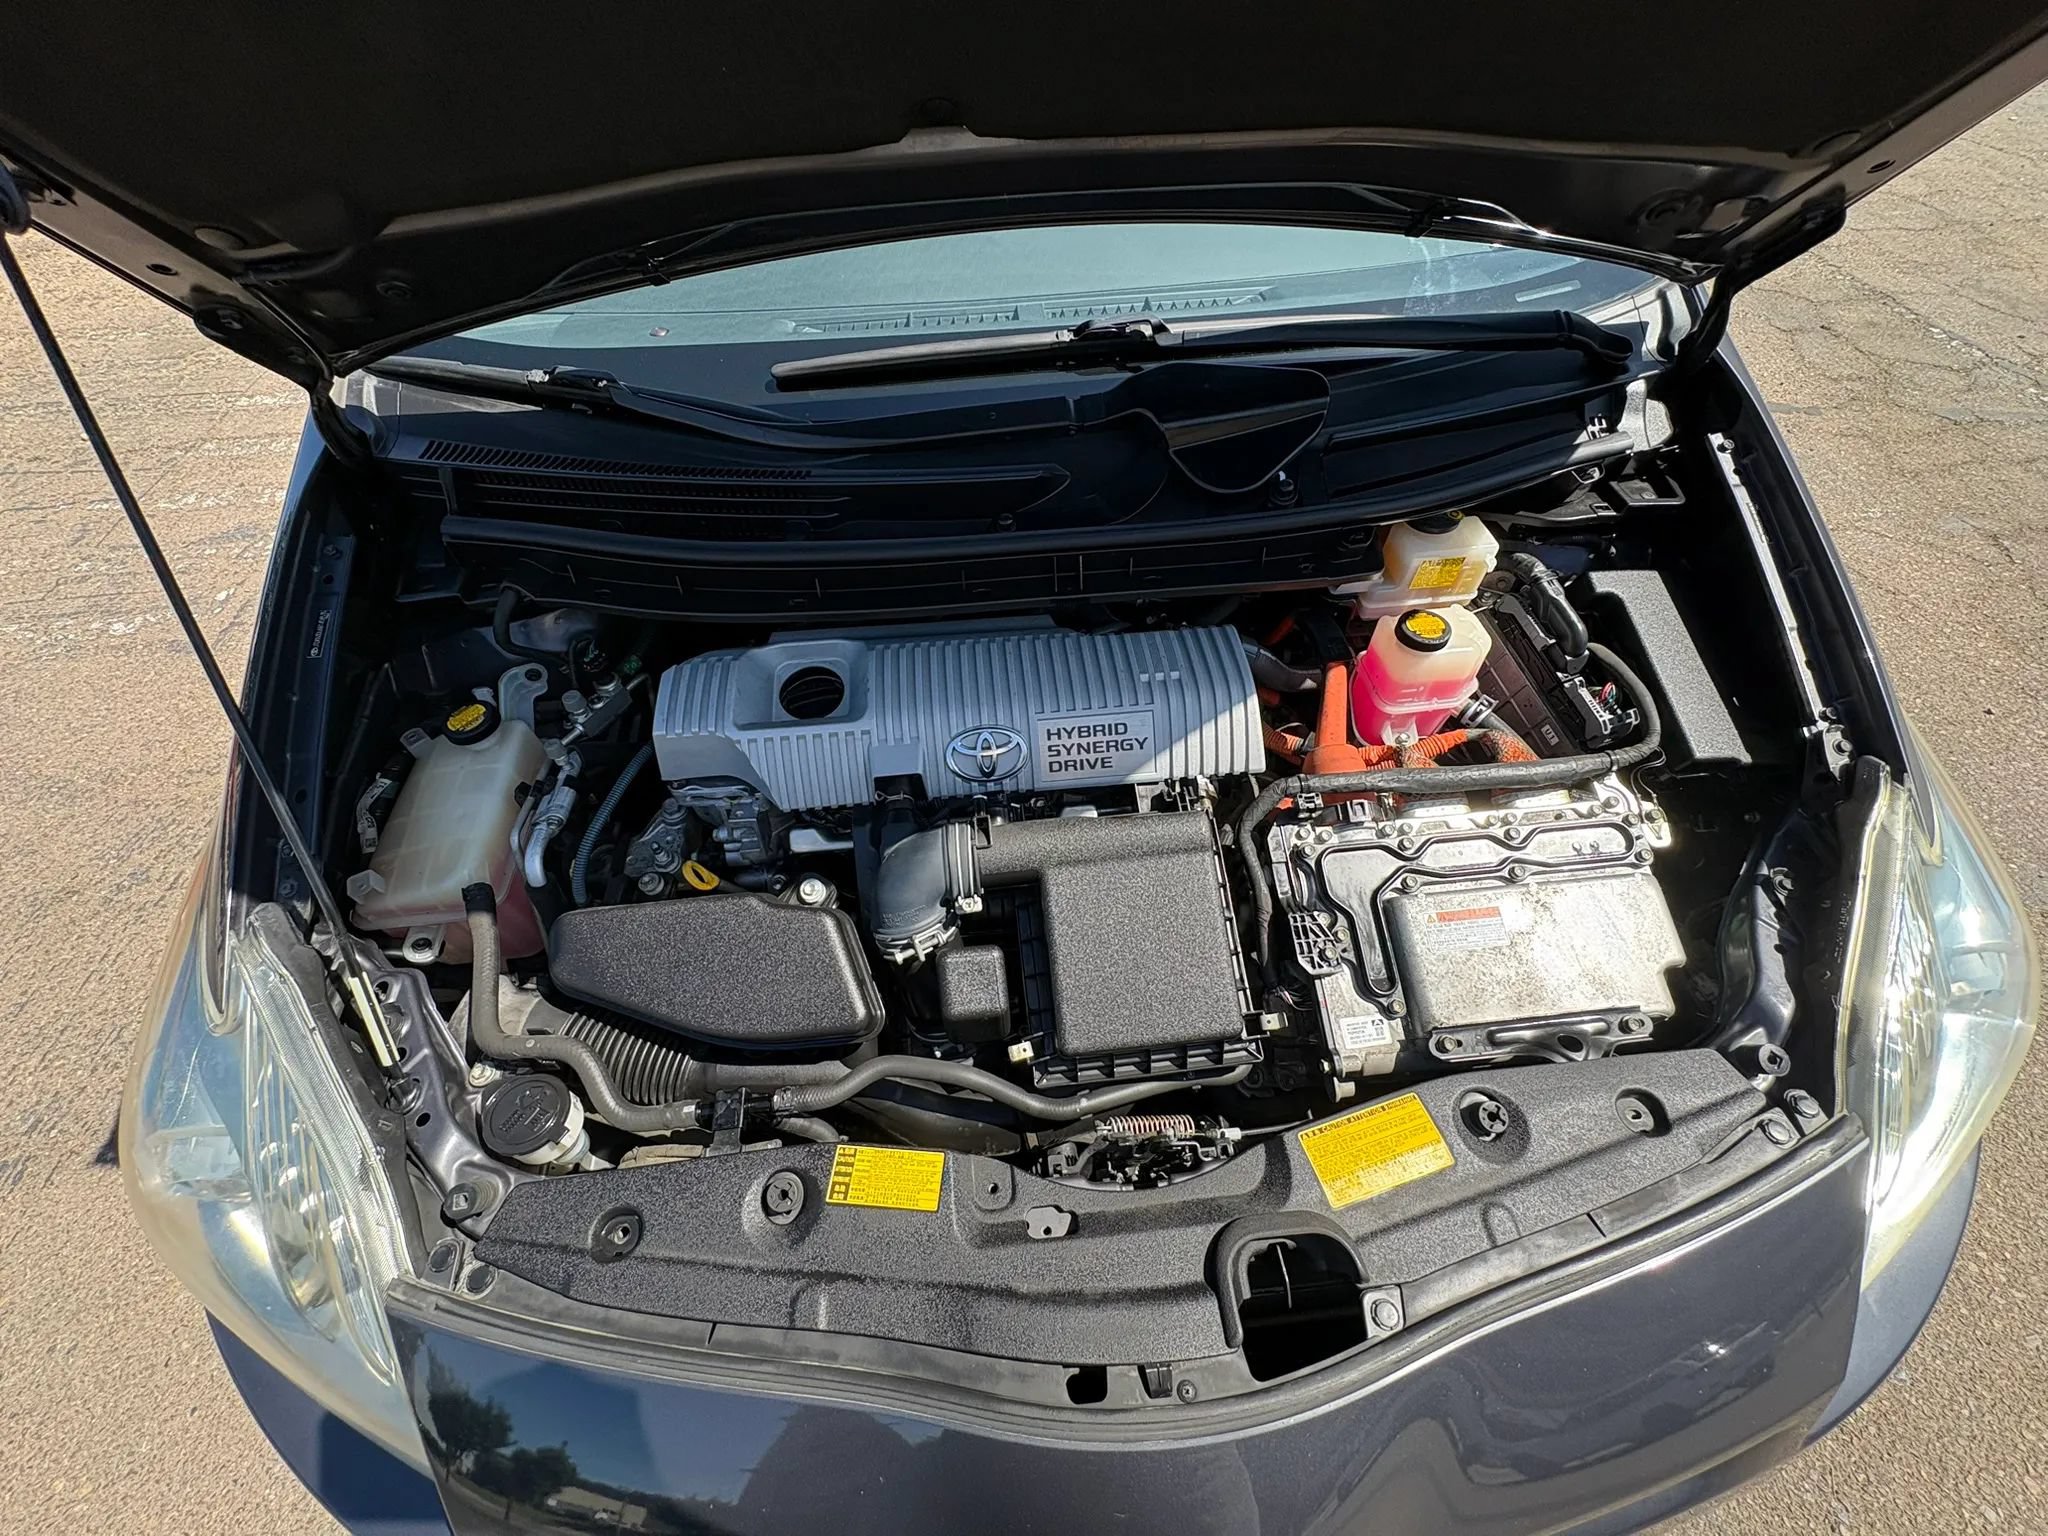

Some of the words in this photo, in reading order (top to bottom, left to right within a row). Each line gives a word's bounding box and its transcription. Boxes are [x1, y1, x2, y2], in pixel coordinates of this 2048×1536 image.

[1046, 722, 1128, 741] HYBRID
[1048, 737, 1149, 757] SYNERGY
[1048, 756, 1113, 773] DRIVE
